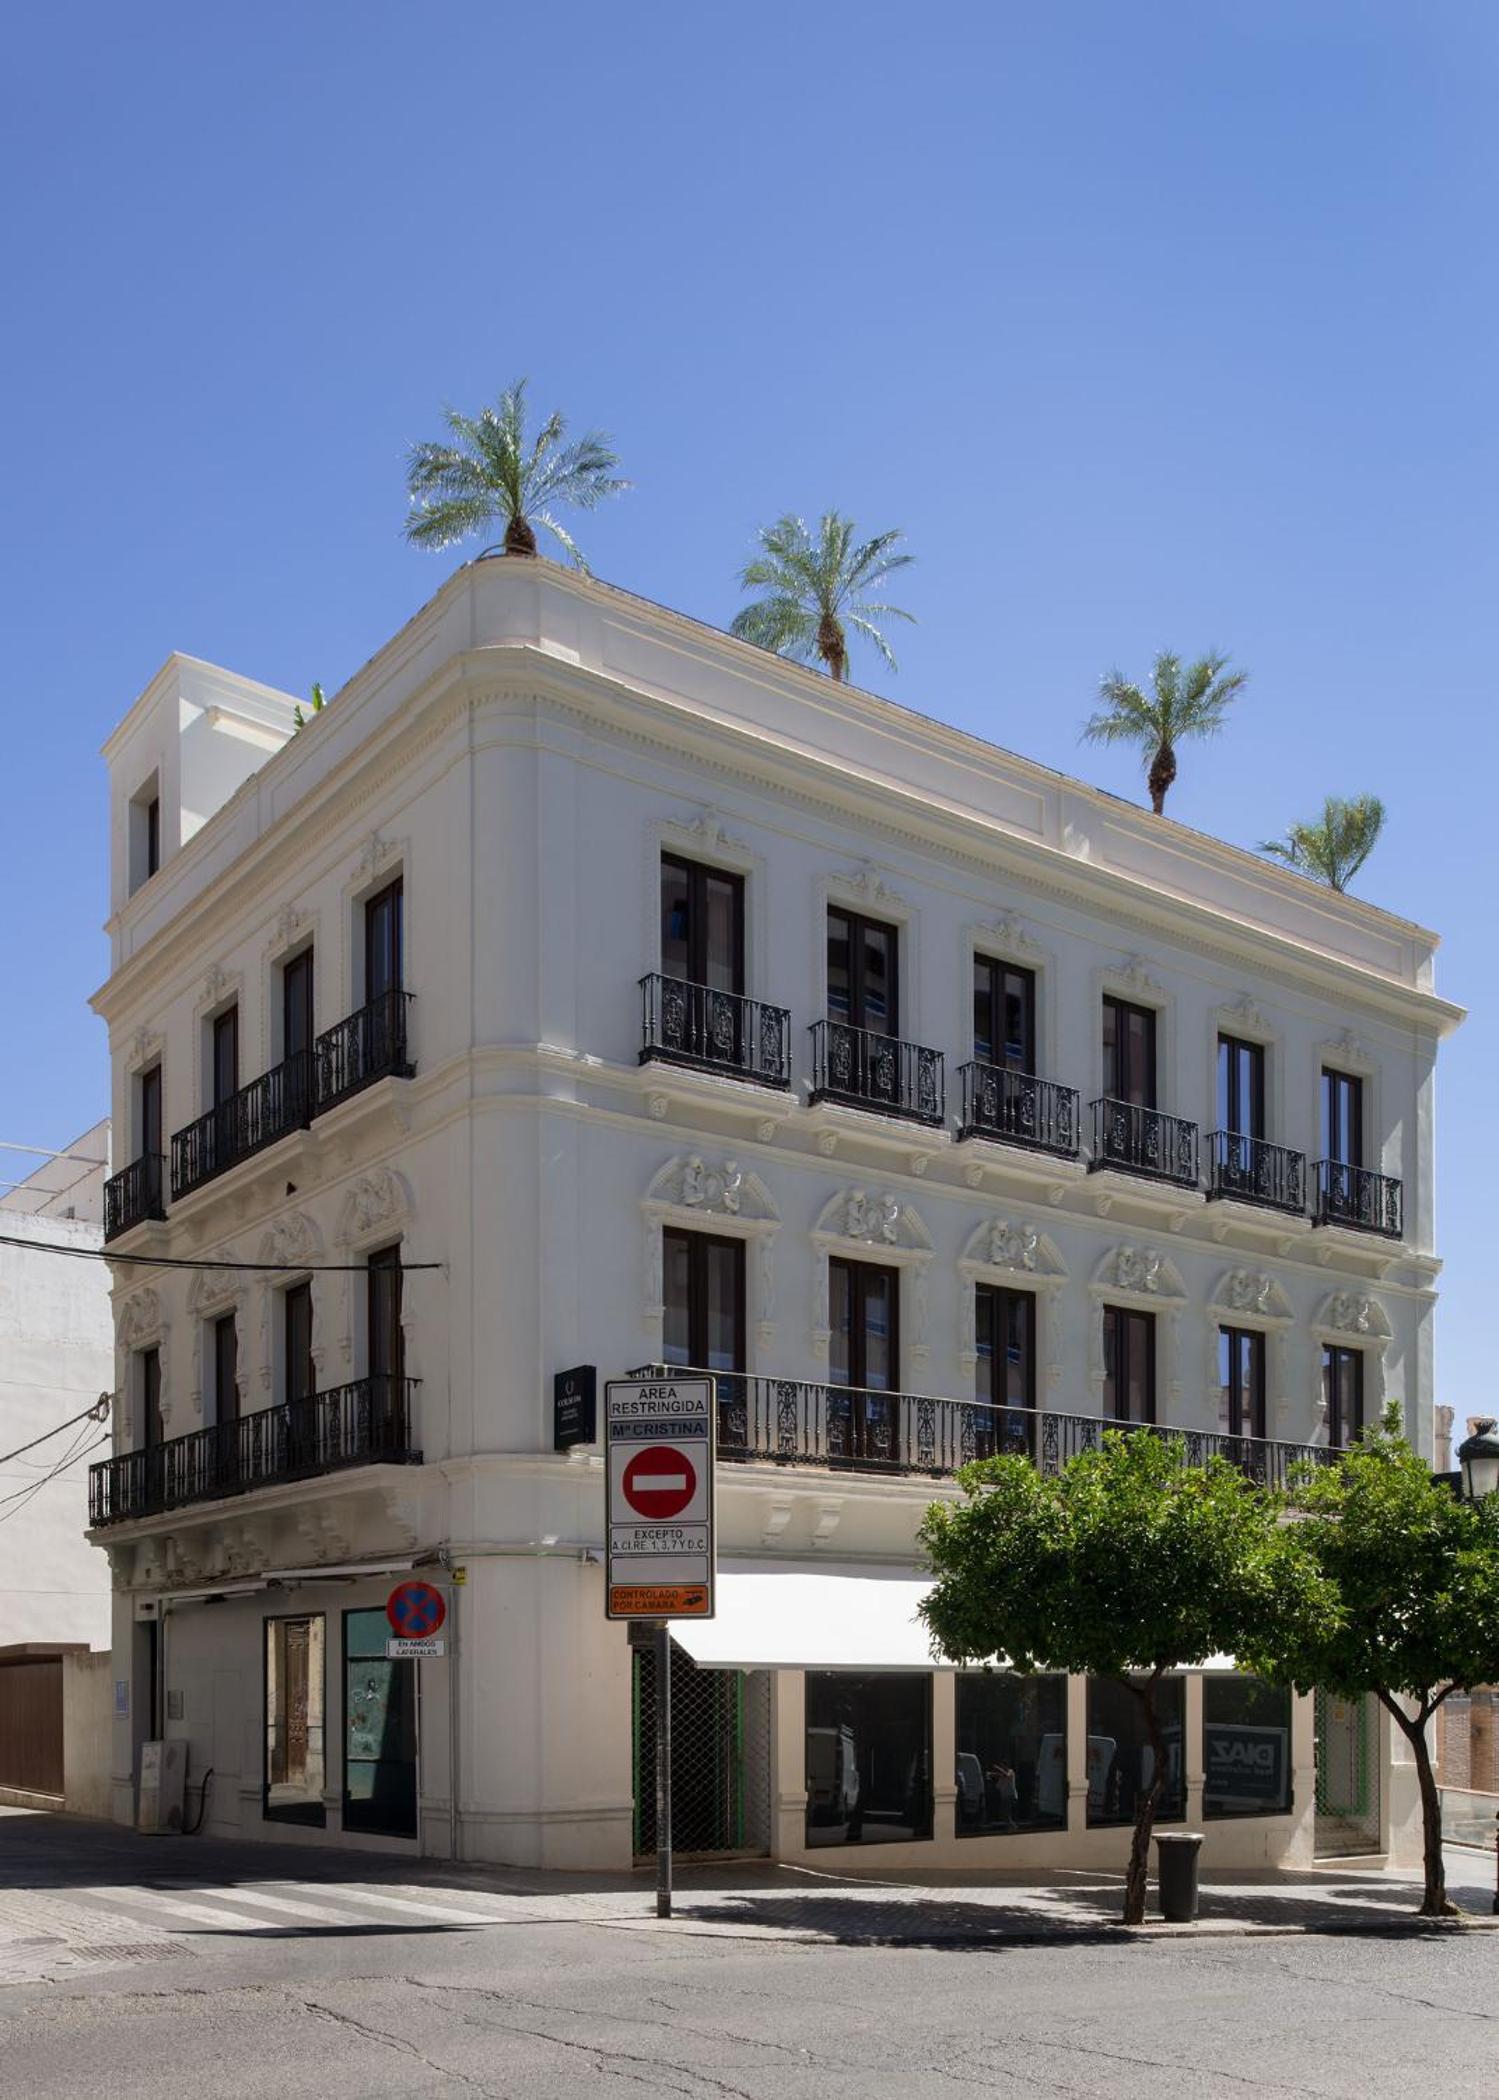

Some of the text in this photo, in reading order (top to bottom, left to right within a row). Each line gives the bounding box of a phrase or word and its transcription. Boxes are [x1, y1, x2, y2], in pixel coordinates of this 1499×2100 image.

[639, 1387, 677, 1400] AREA
[612, 1400, 705, 1414] RESTRINGIDA
[633, 1422, 704, 1436] CRISTINA
[634, 1529, 683, 1539] EXCEPTO
[613, 1590, 679, 1599] CONTROLADO
[613, 1601, 633, 1609] POR
